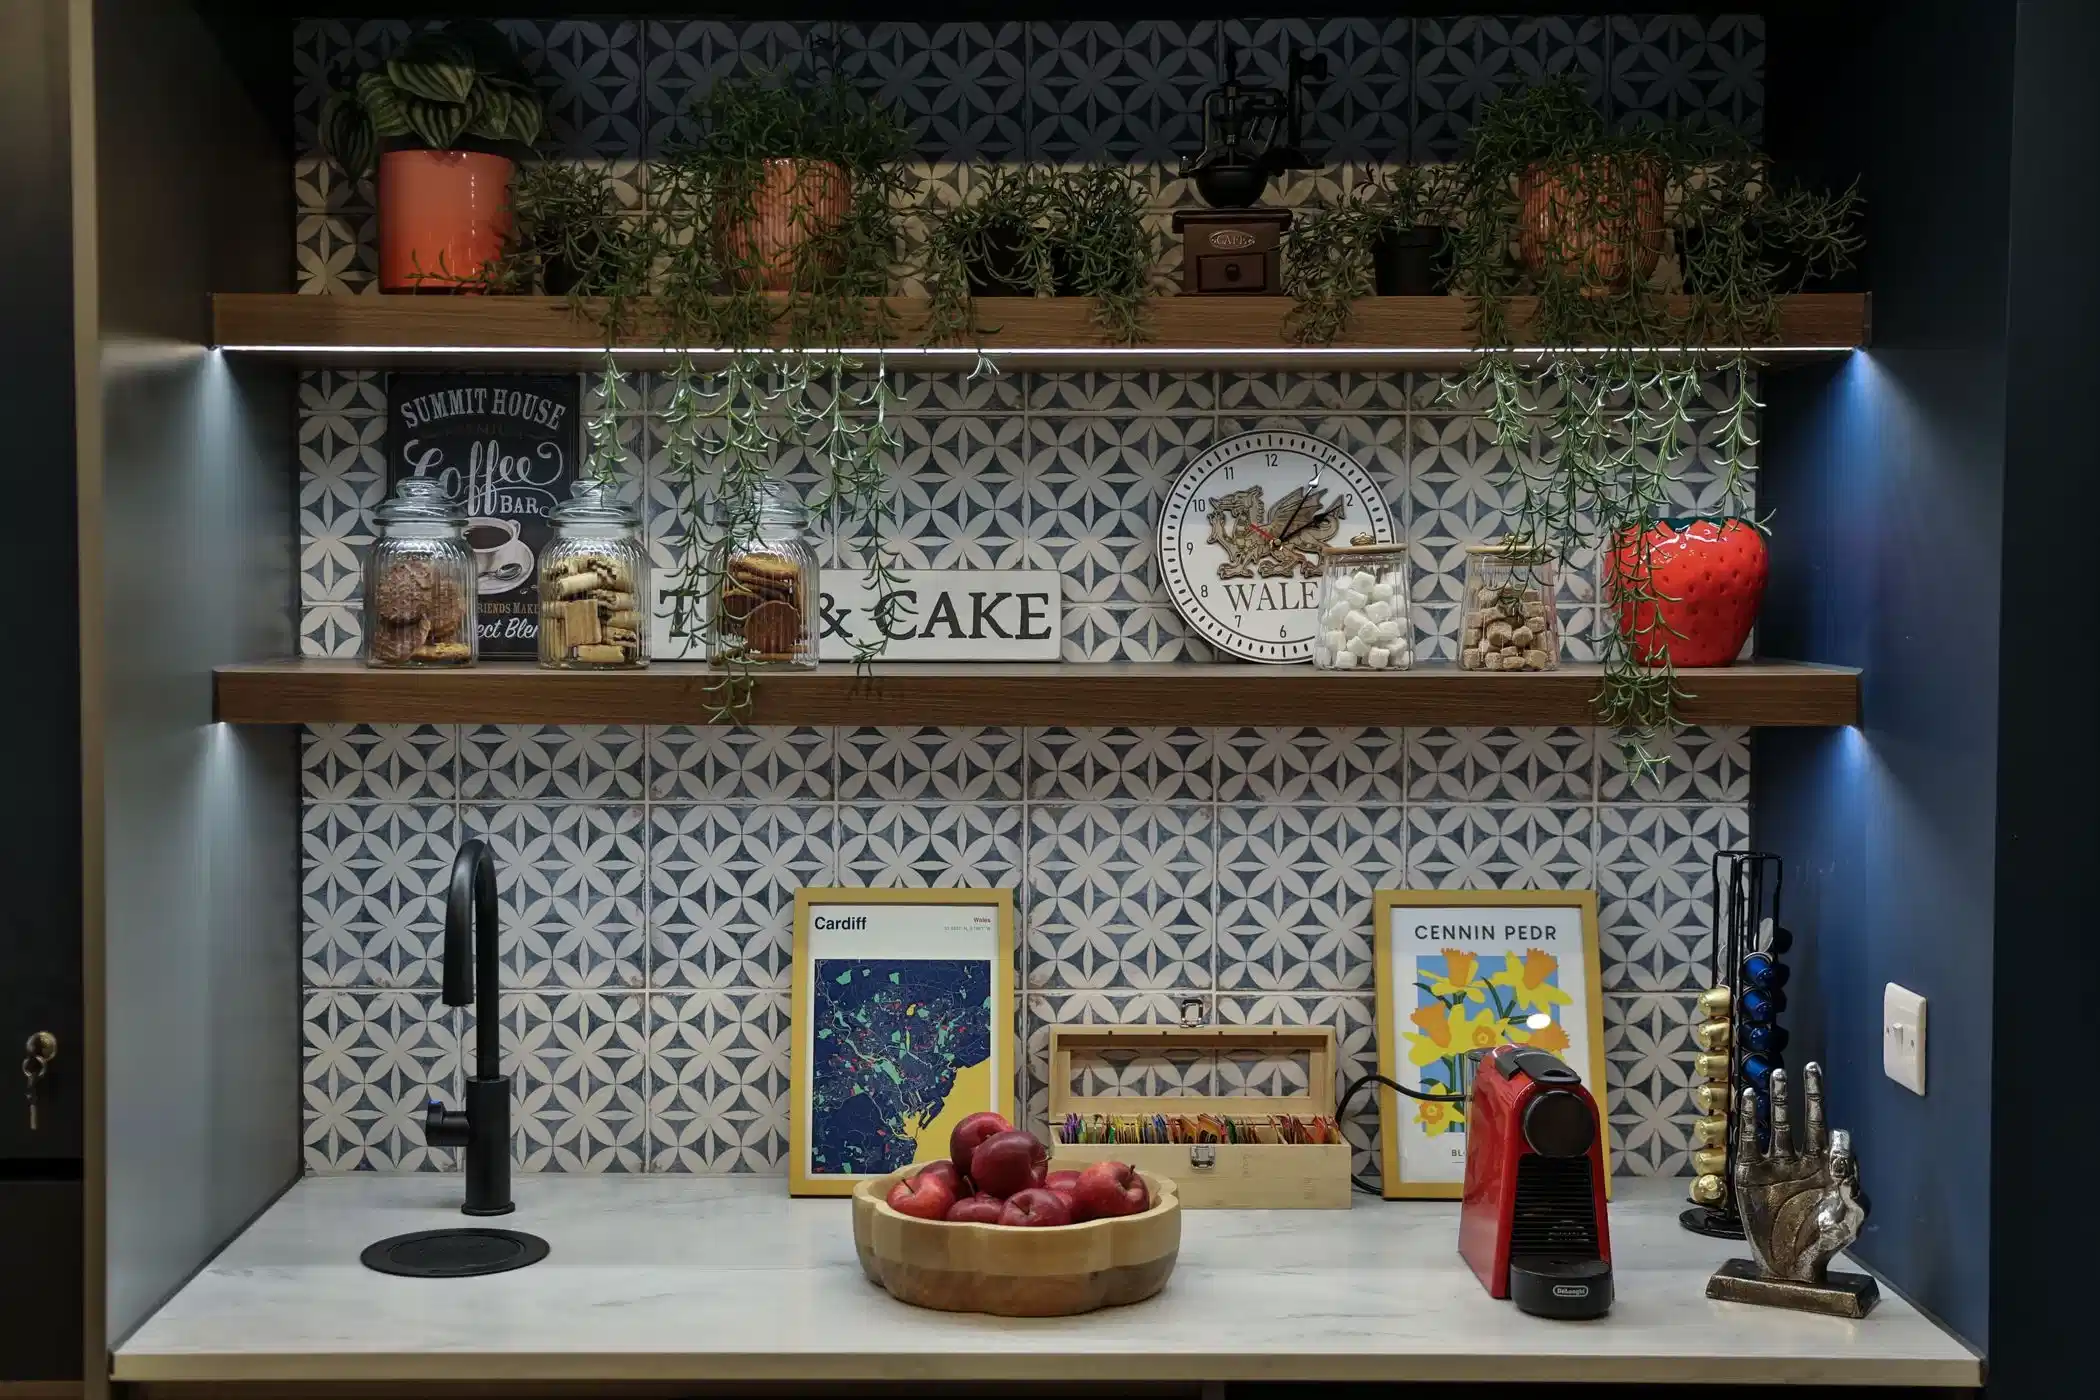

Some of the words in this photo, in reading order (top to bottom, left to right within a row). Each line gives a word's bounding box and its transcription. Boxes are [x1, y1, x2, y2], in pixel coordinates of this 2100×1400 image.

[401, 388, 487, 429] SUMMIT
[491, 388, 567, 431] HOUSE
[1265, 453, 1278, 467] 12
[1224, 466, 1234, 480] 11
[500, 495, 538, 514] BAR
[1192, 499, 1206, 513] 10
[1346, 493, 1353, 507] 2
[1186, 542, 1194, 556] 9
[1200, 584, 1209, 598] 8
[1222, 581, 1320, 612] WALE
[478, 602, 511, 614] RIENDS
[873, 590, 1052, 640] CAKE
[1234, 614, 1242, 628] 7
[1279, 624, 1287, 639] 6
[814, 916, 867, 930] Cardiff
[1414, 925, 1496, 941] CENNIN
[1505, 925, 1557, 941] PEDR
